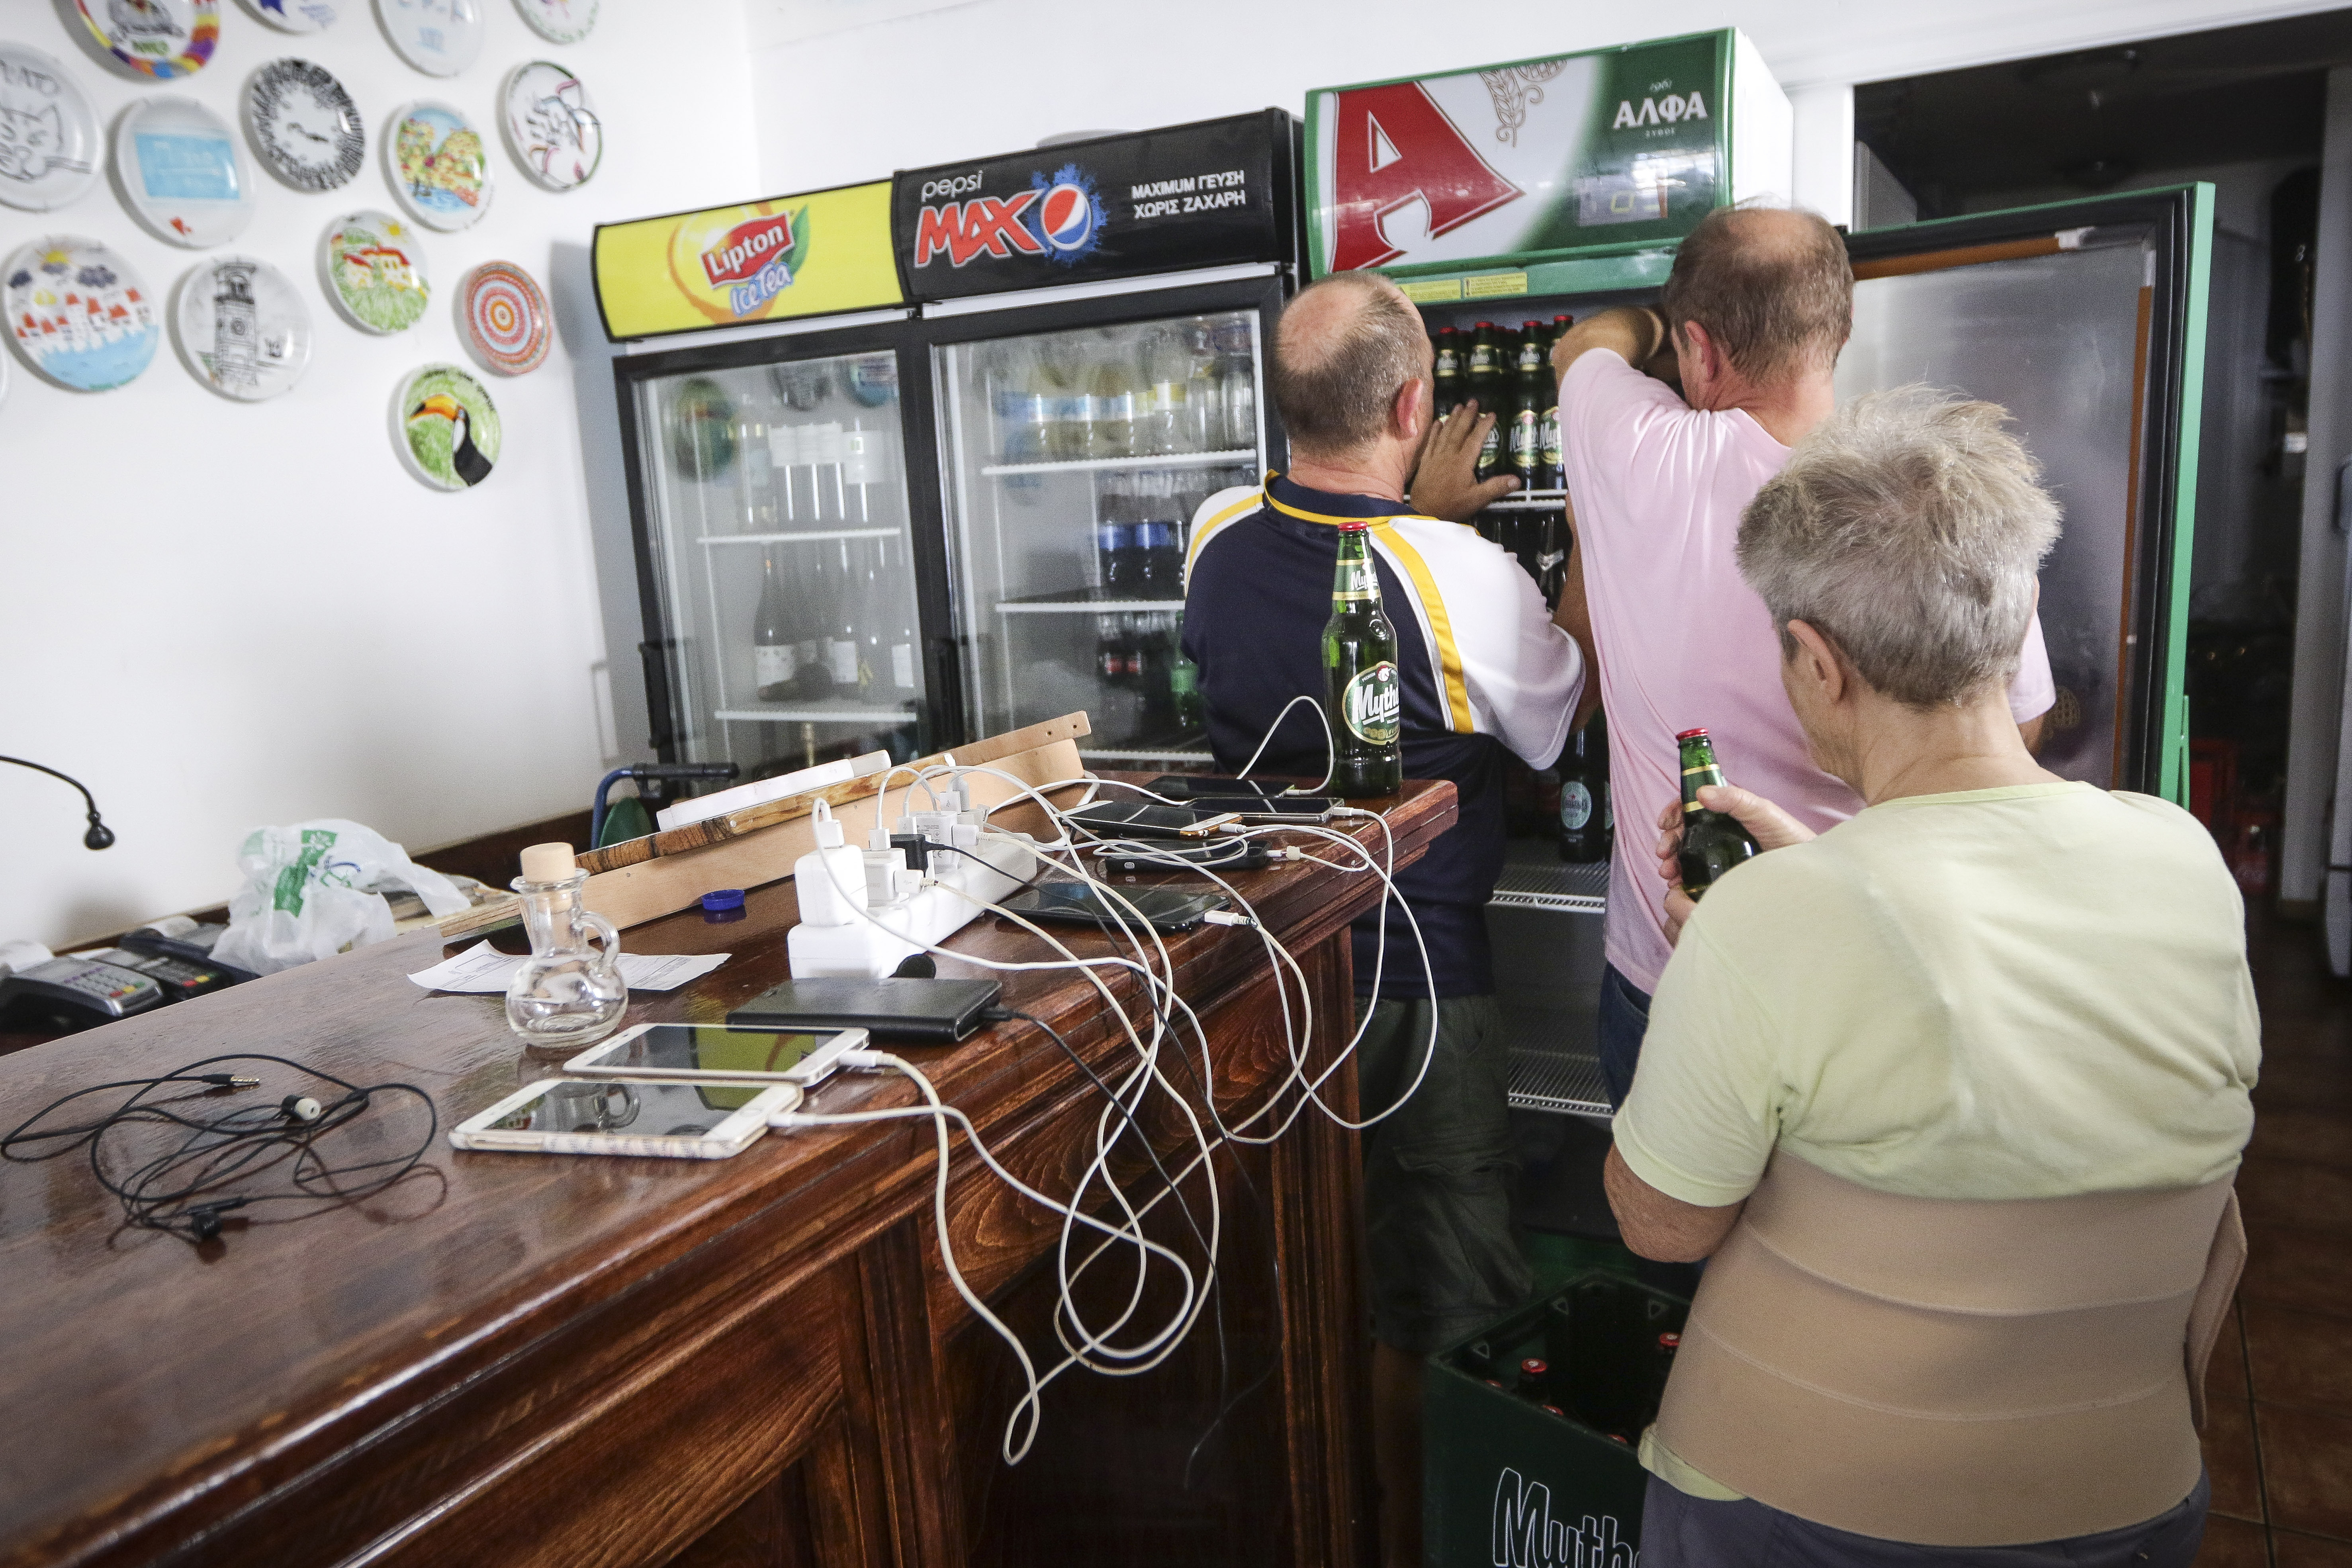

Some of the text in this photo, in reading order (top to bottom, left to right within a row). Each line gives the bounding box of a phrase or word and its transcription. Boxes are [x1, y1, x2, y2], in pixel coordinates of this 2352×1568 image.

[1612, 91, 1708, 129] ΑΛΦΑ
[921, 170, 983, 202] pepsi
[1132, 170, 1244, 200] MAXIMUM ΓΕΥΣΗ
[1133, 190, 1246, 219] ΧΩΡΙΣ ΖΑΧΑΡΗ
[706, 224, 785, 277] Lipton
[914, 189, 1046, 269] MAX
[731, 262, 792, 315] Ice Tea
[1492, 1467, 1640, 1568] Myth
